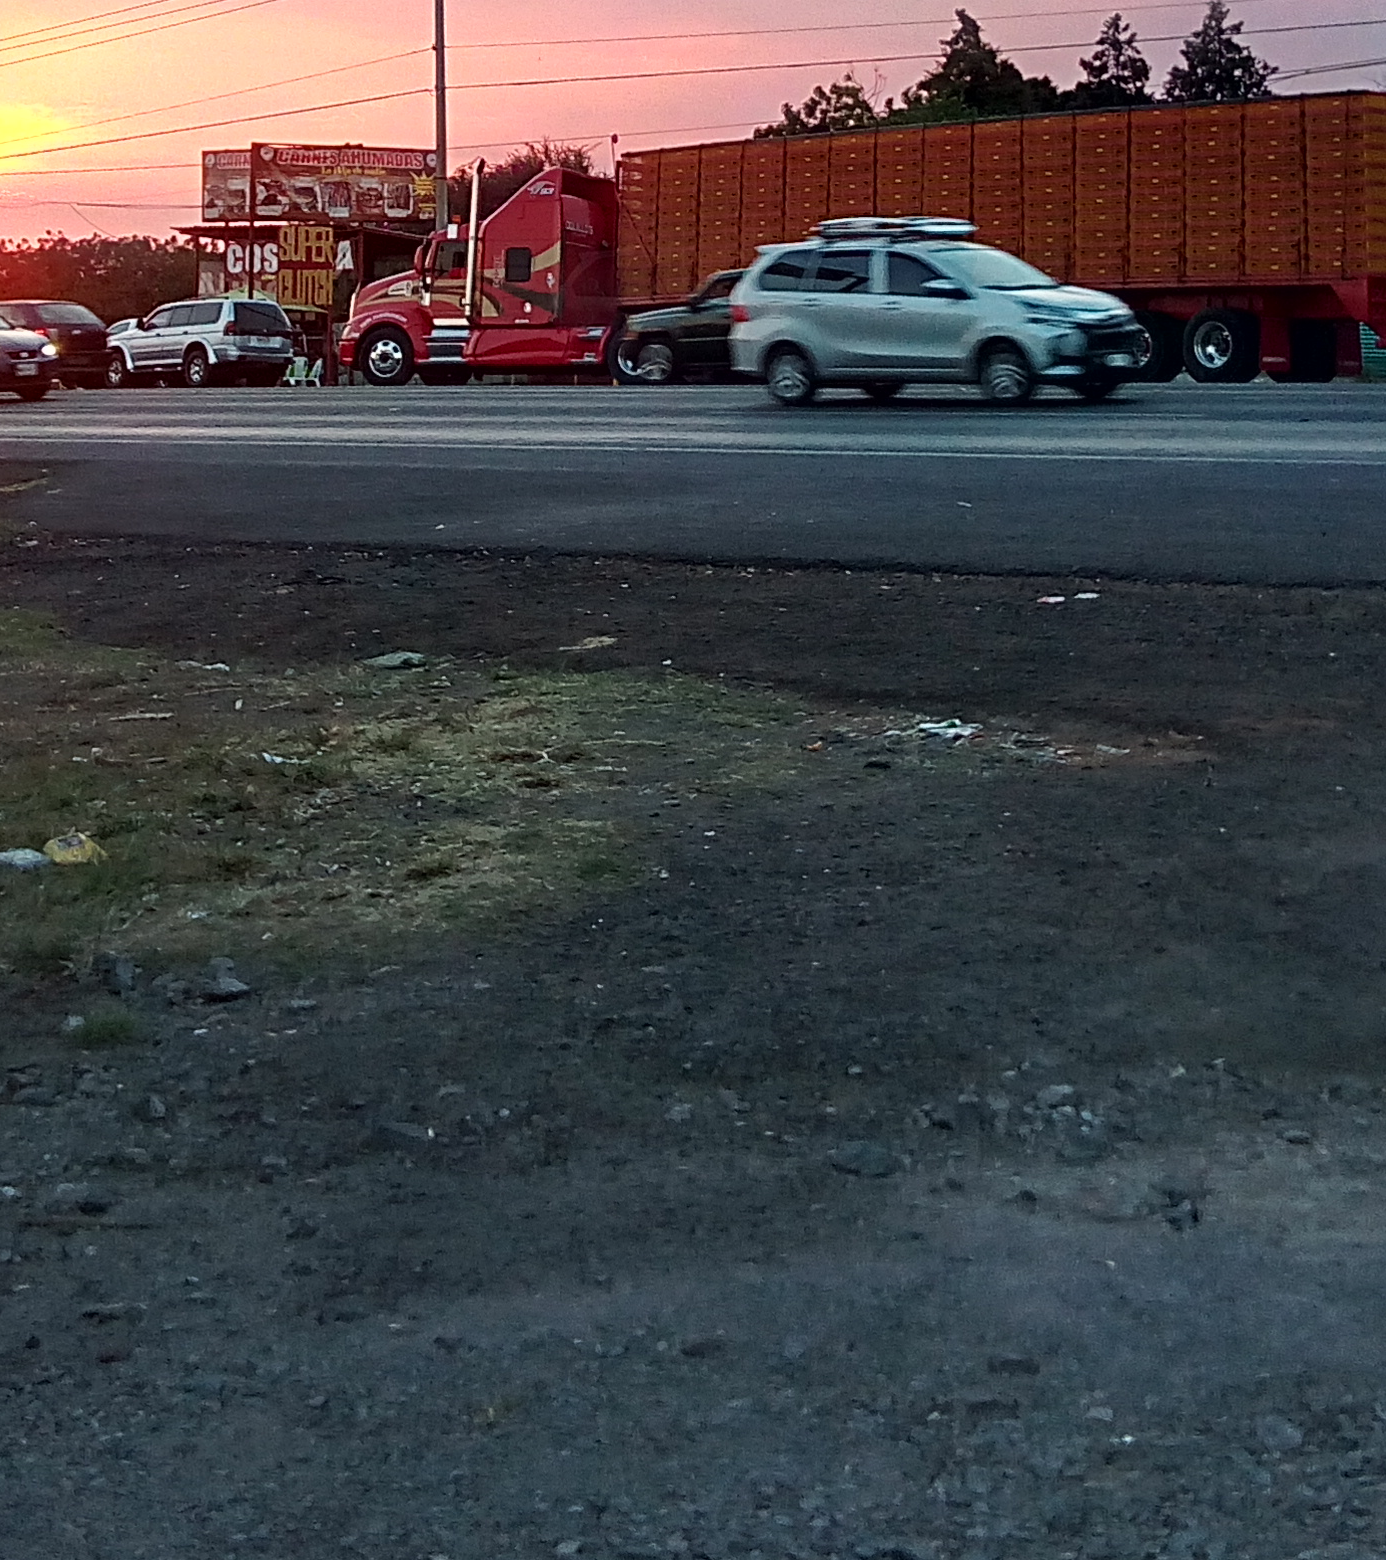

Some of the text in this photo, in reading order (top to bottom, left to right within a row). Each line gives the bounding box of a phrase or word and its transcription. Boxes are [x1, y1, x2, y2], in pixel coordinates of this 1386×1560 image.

[276, 149, 424, 169] CARNES AHUMADAS
[279, 225, 335, 266] SUPER
[278, 269, 334, 305] CLUTCH
